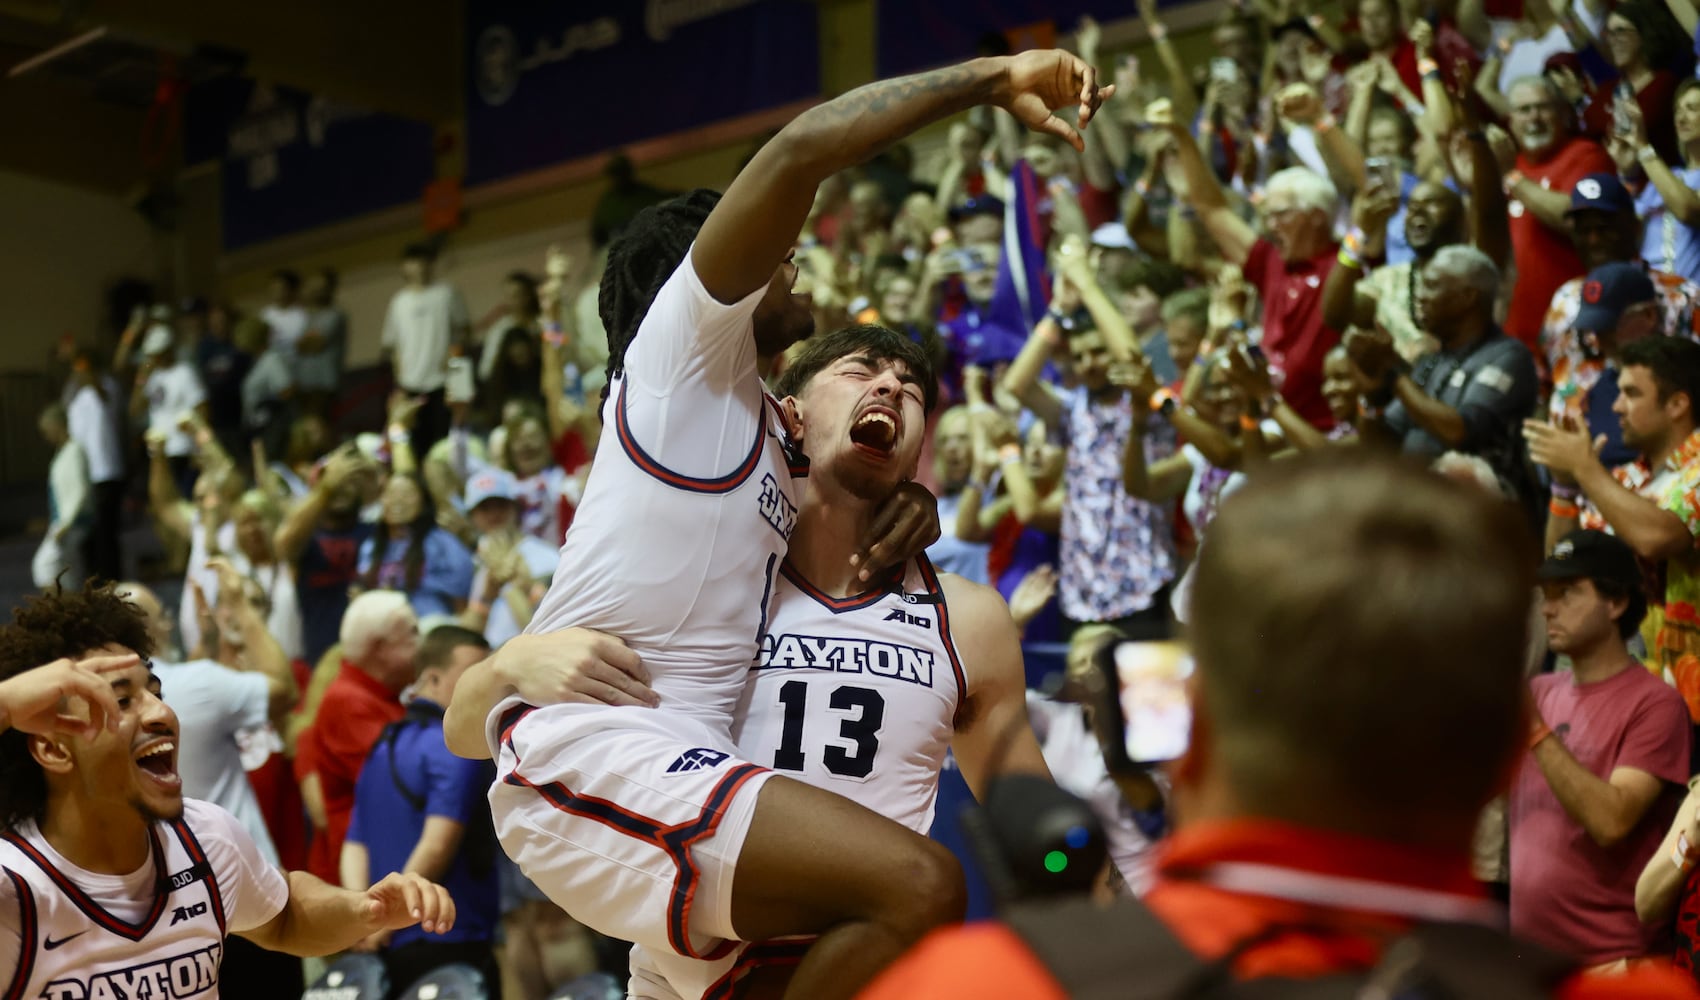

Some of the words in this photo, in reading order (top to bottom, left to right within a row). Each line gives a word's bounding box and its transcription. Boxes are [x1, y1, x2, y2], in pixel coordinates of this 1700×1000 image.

[883, 607, 931, 629] A10
[774, 680, 885, 779] 13
[172, 871, 194, 888] DJD
[169, 901, 207, 927] A10
